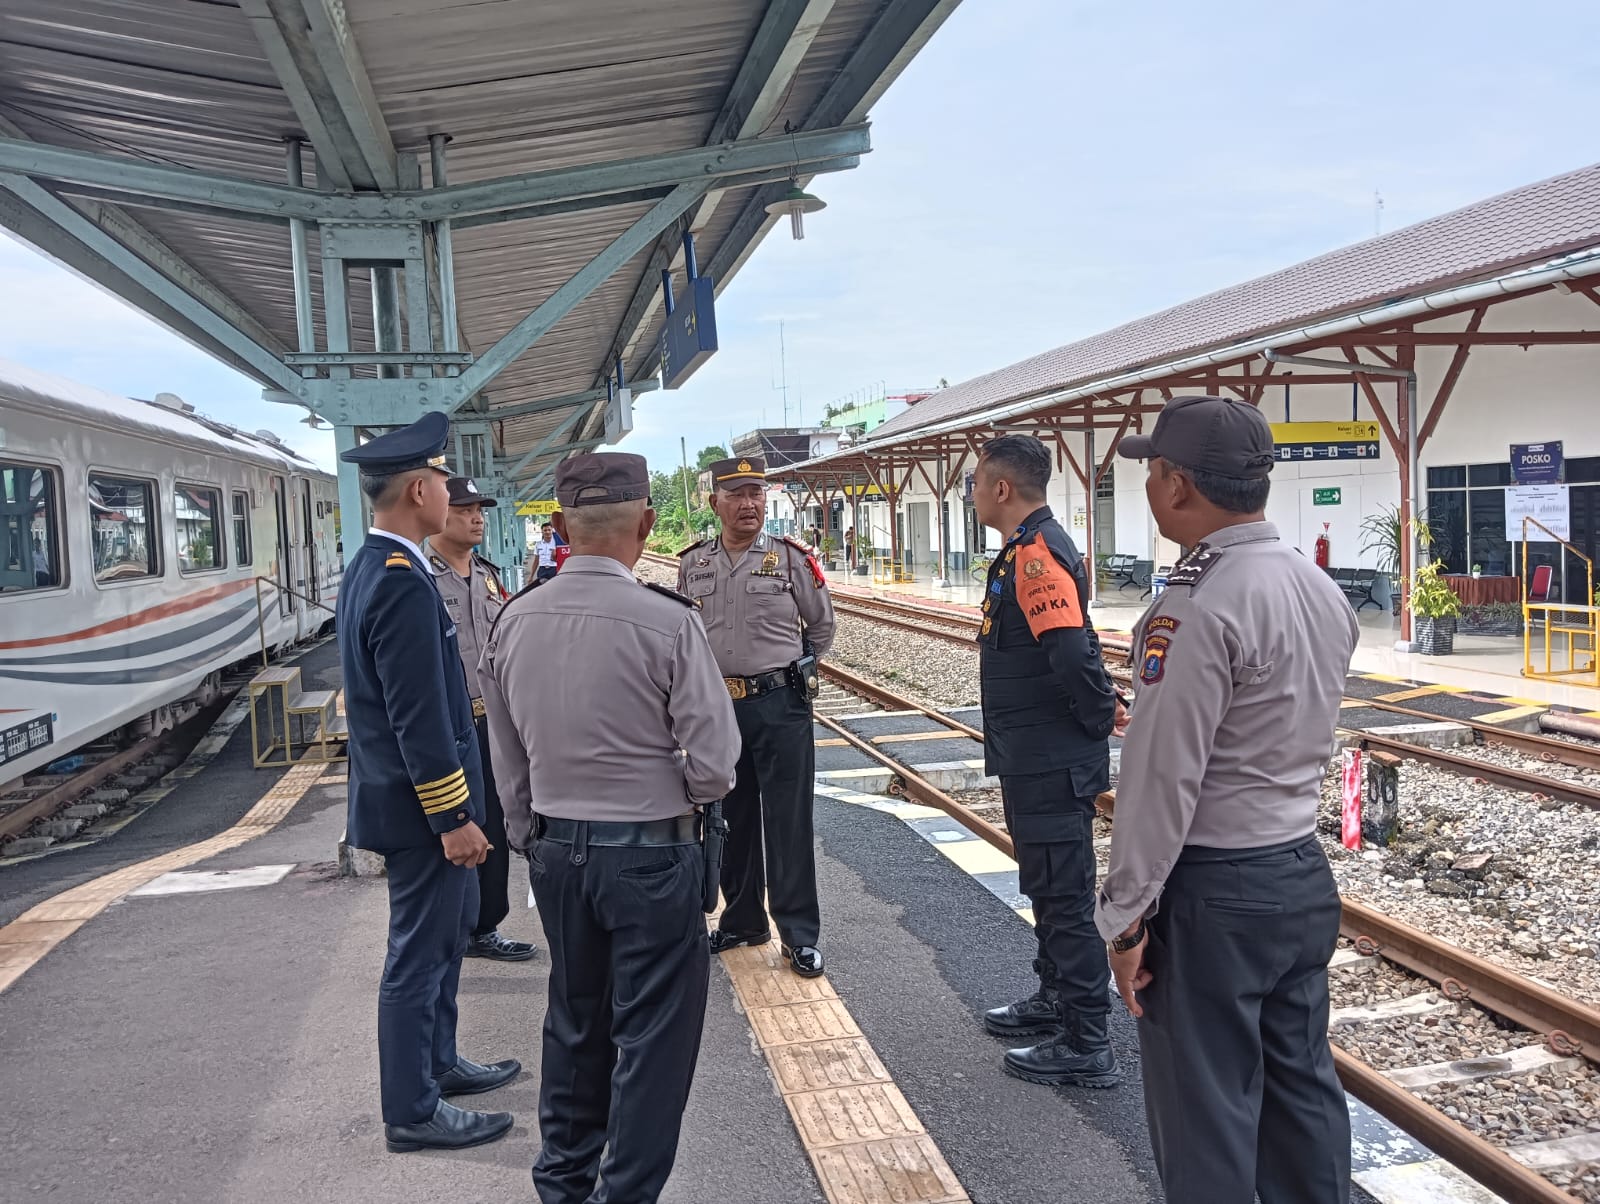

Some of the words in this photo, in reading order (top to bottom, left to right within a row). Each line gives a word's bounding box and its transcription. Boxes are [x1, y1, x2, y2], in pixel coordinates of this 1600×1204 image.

[1521, 454, 1551, 465] POSKO
[1047, 583, 1056, 591] SU
[1050, 598, 1070, 610] KA
